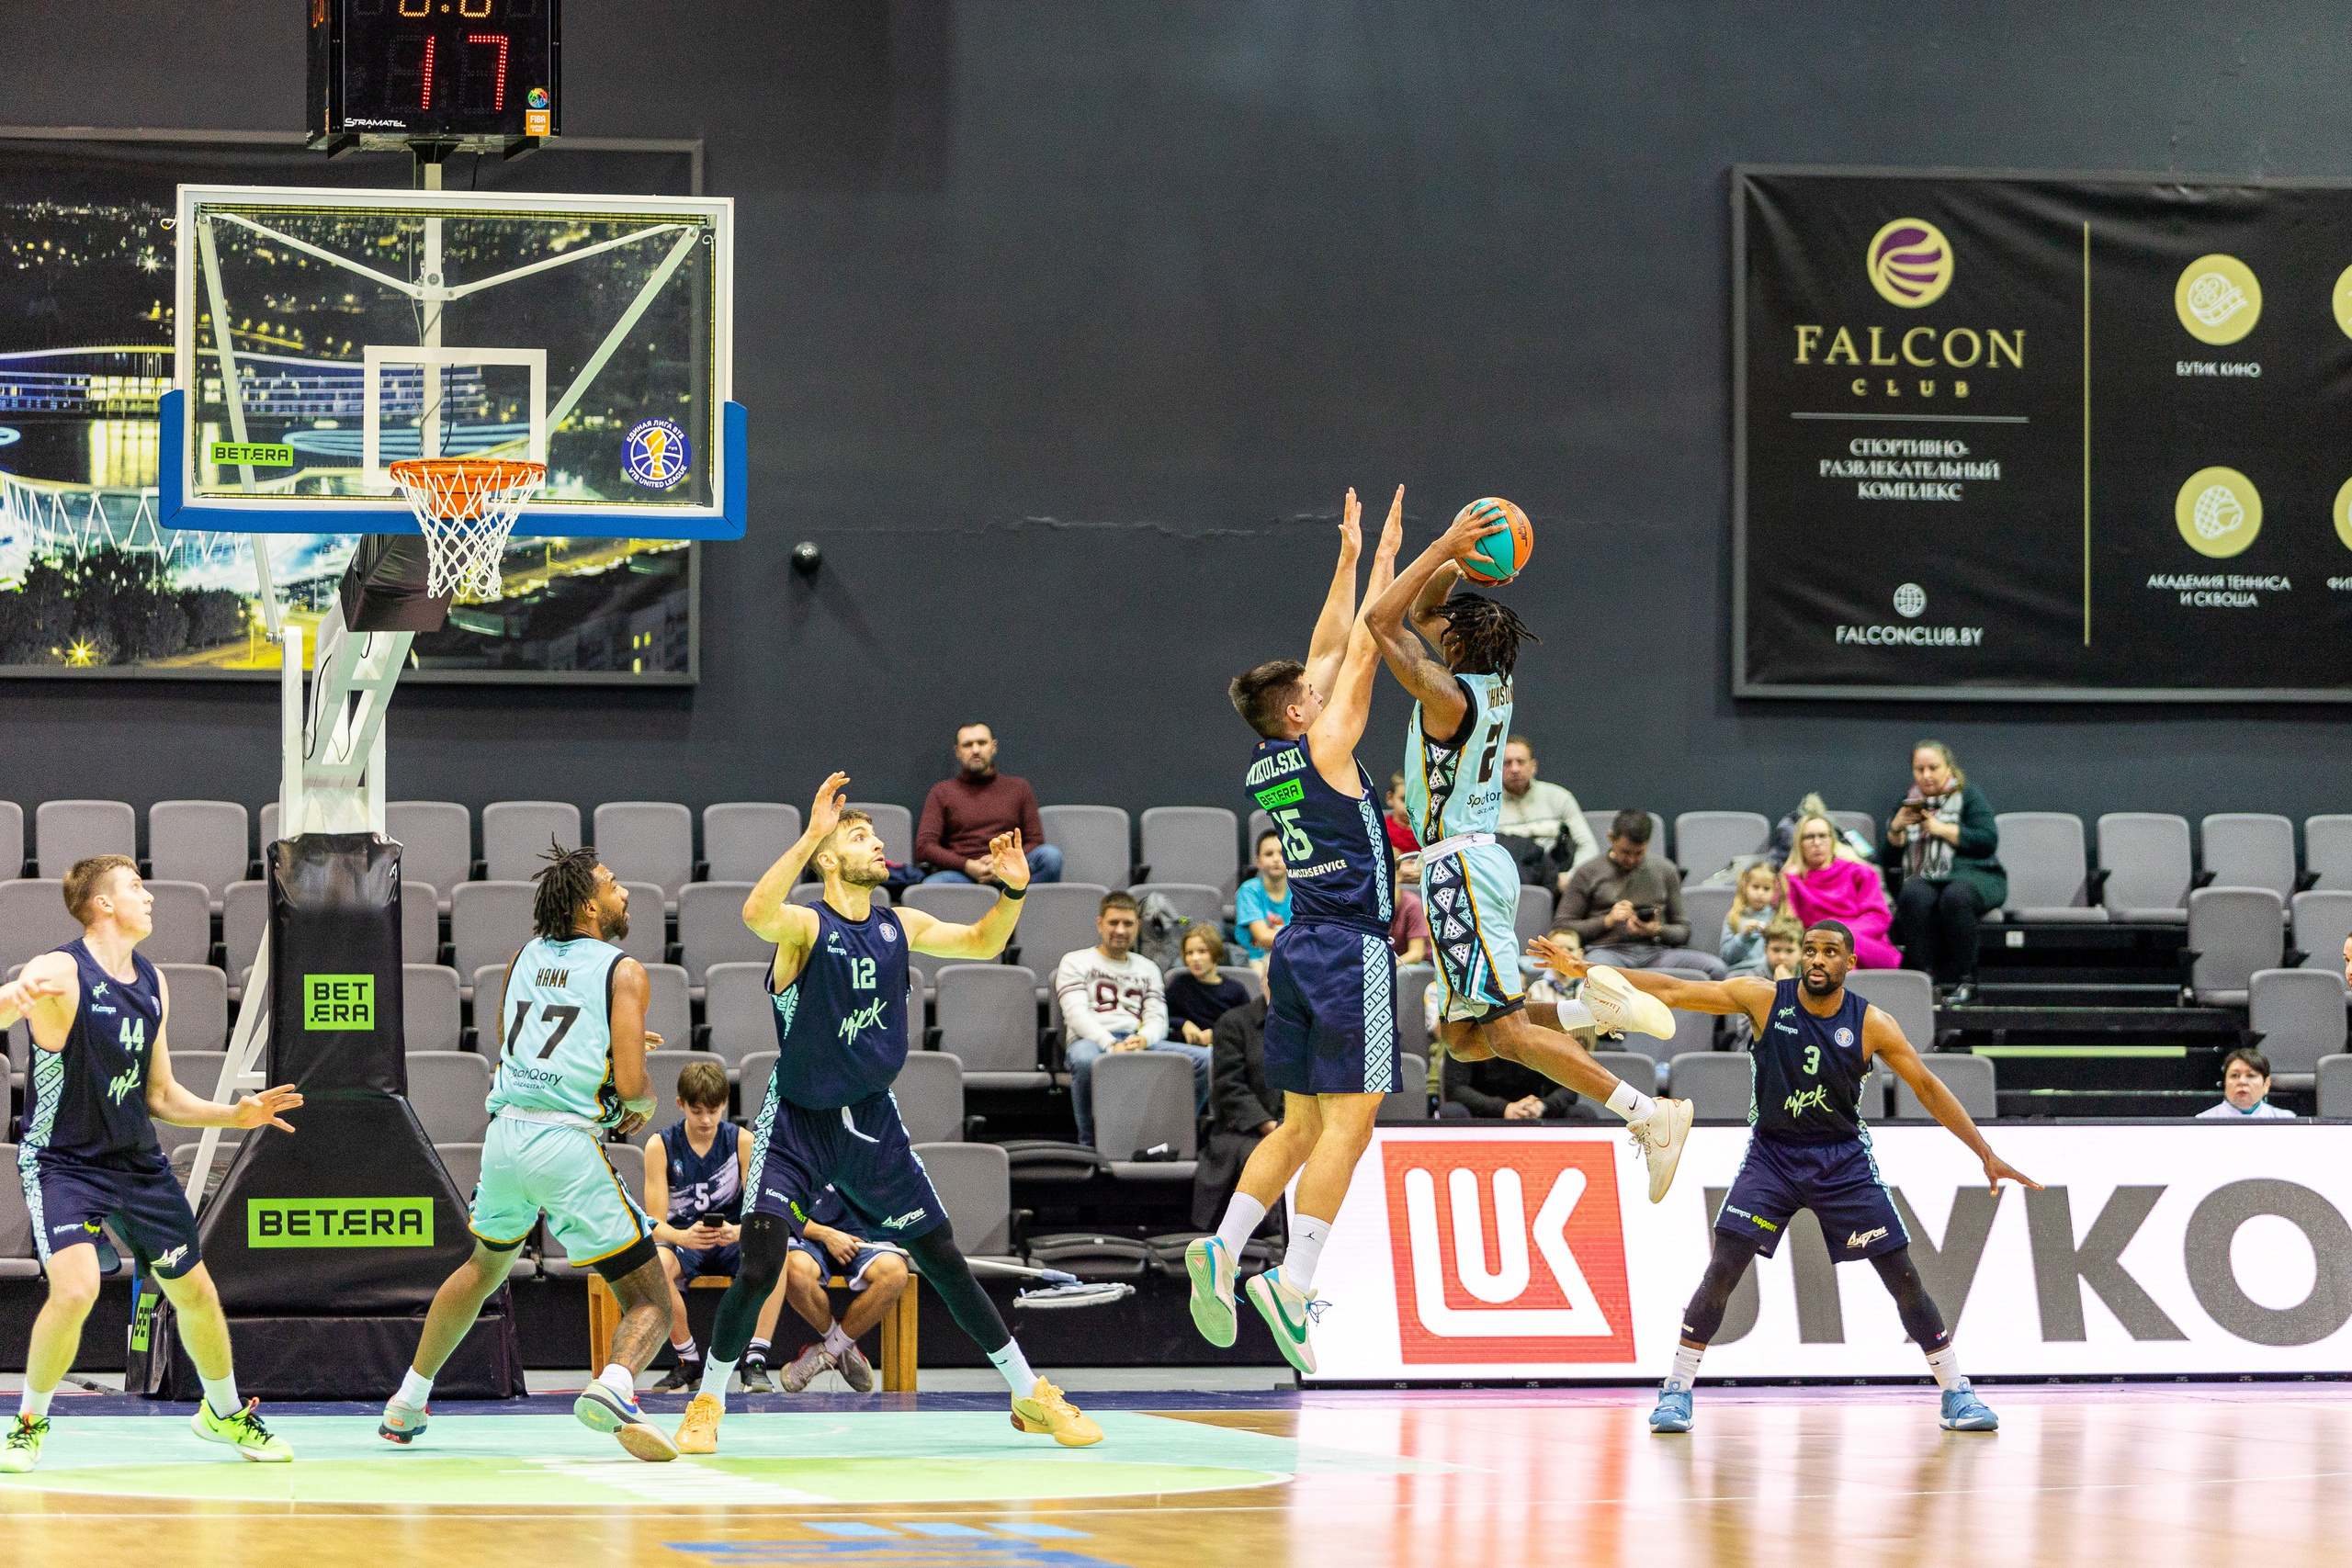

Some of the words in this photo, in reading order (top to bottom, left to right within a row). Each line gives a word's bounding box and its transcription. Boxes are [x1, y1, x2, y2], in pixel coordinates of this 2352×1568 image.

[422, 35, 508, 111] 17
[344, 118, 407, 129] STRAMATEL
[529, 115, 547, 124] FIBA
[1792, 324, 2027, 369] FALCON
[2175, 360, 2220, 378] БУТИК
[2220, 361, 2262, 378] КИНО
[1850, 378, 1971, 399] CLUB
[626, 420, 652, 443] ЕДИНАЯ
[652, 419, 673, 430] ЛИГА
[672, 425, 685, 440] ВТБ
[1849, 437, 1971, 458] СПОРТИВНО-
[628, 467, 640, 481] VTB
[639, 476, 665, 489] UNITED
[664, 464, 687, 487] LEAGUE
[1819, 458, 2001, 481] РАЗВЛЕКАТЕЛЬНЫЙ
[1857, 480, 1963, 502] КОМПЛЕКС
[2145, 573, 2225, 591] АКАДЕМИЯ
[2226, 574, 2293, 592] ТЕННИСА
[2193, 591, 2260, 608] СКВОША
[1836, 625, 1984, 646] FALCONCLUB.BY
[1476, 720, 1504, 784] 2
[1272, 808, 1314, 862] 15
[535, 967, 570, 989] HAMM
[850, 957, 876, 989] 12
[313, 983, 368, 1000] BET
[119, 1017, 145, 1051] 44
[507, 1000, 582, 1060] 17
[1774, 1021, 1798, 1034] Kempa
[1803, 1044, 1821, 1076] 3
[694, 1182, 710, 1212] 5
[764, 1188, 789, 1203] Kempa
[1726, 1204, 1751, 1219] Kempa
